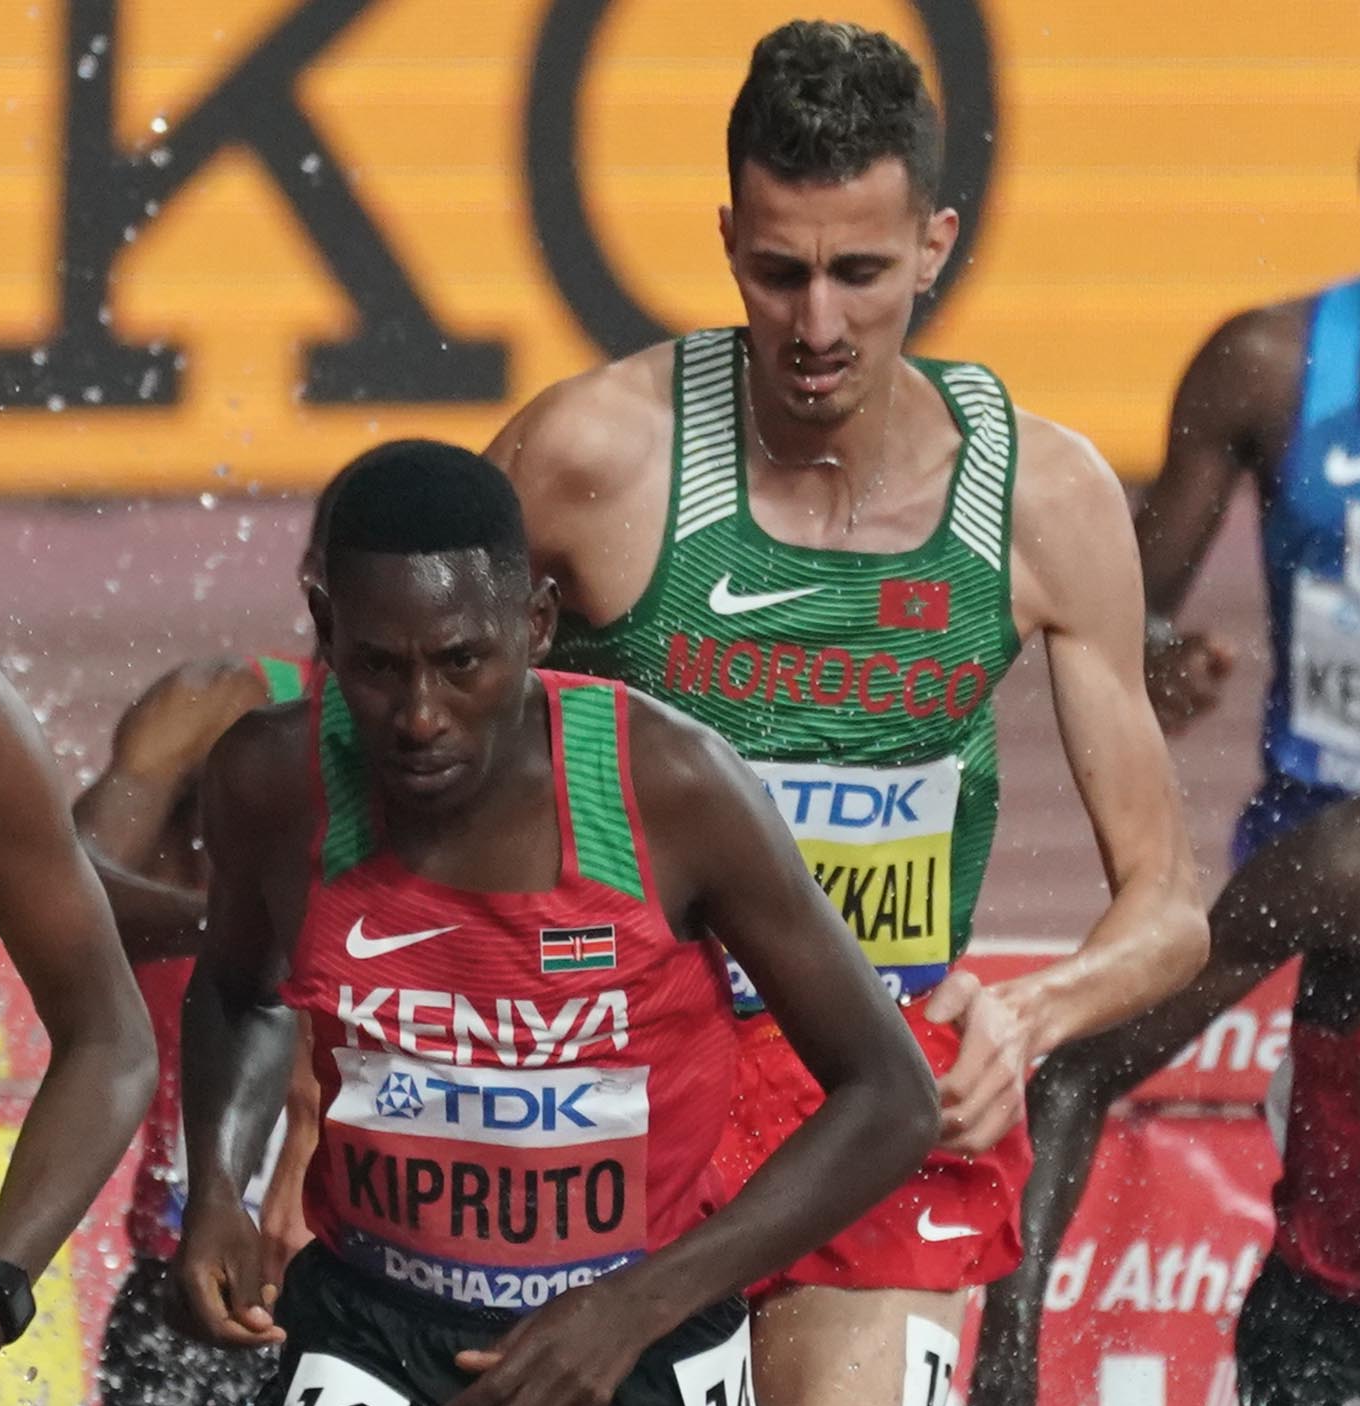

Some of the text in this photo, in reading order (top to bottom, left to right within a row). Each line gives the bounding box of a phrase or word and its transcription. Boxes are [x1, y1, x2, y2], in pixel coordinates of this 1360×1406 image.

[664, 633, 988, 720] MOROCCO
[781, 778, 926, 829] TDK
[338, 985, 630, 1067] KENYA
[426, 1078, 597, 1132] TDK
[343, 1143, 626, 1245] KIPRUTO
